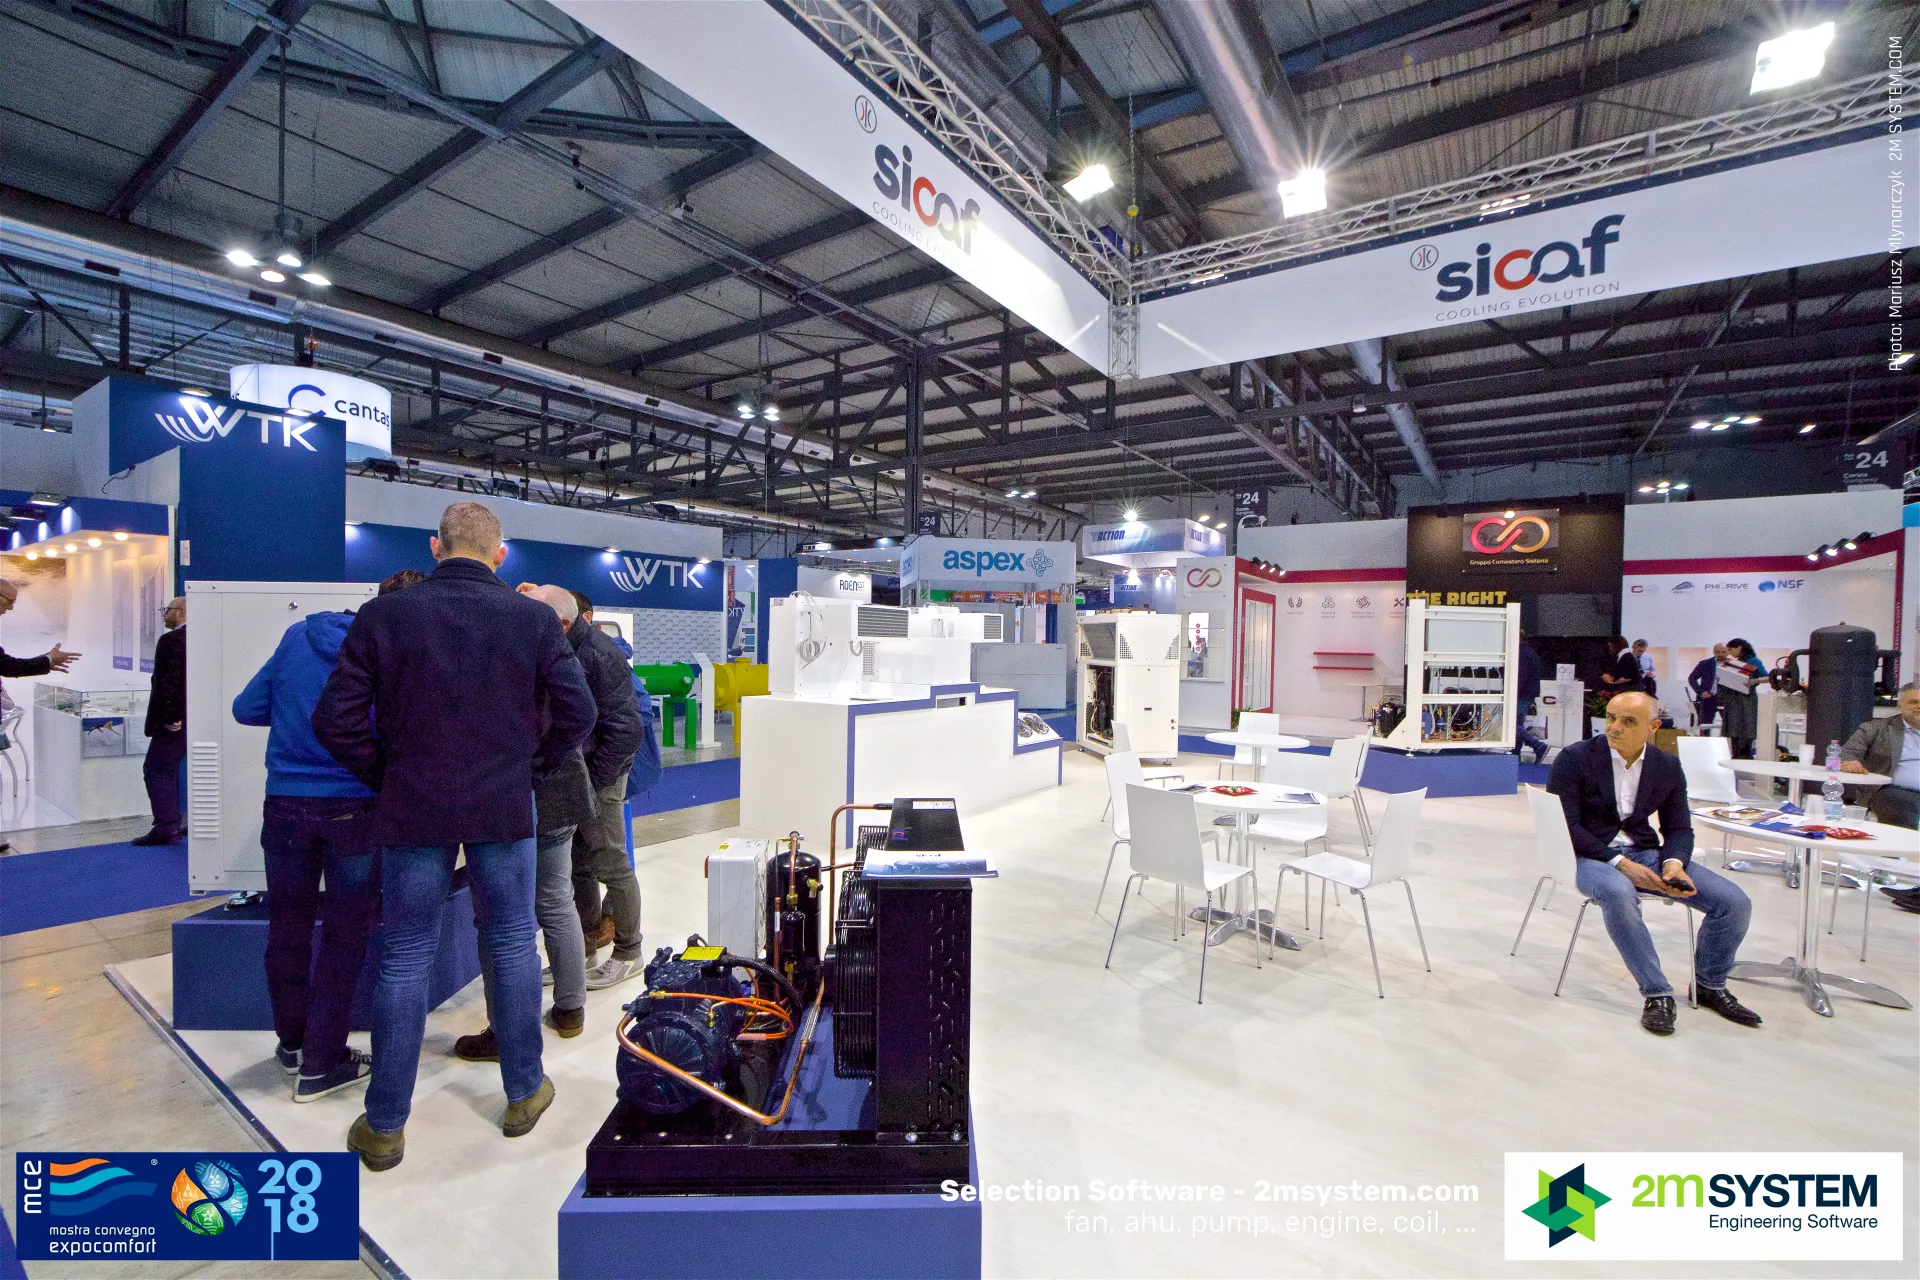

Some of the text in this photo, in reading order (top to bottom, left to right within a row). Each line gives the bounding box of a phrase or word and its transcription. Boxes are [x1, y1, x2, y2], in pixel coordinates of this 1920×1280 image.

[873, 144, 981, 256] sicaf
[872, 201, 922, 243] COOLING
[1435, 214, 1625, 302] sicaf
[1436, 281, 1620, 321] COOLING EVOLUTION
[155, 397, 318, 452] WTK
[1855, 450, 1889, 469] 24
[1242, 491, 1260, 504] 24
[924, 516, 936, 527] 24
[609, 556, 704, 593] WTK
[943, 549, 1025, 577] aspex
[1446, 591, 1507, 605] RIGHT
[1778, 579, 1804, 589] NSF
